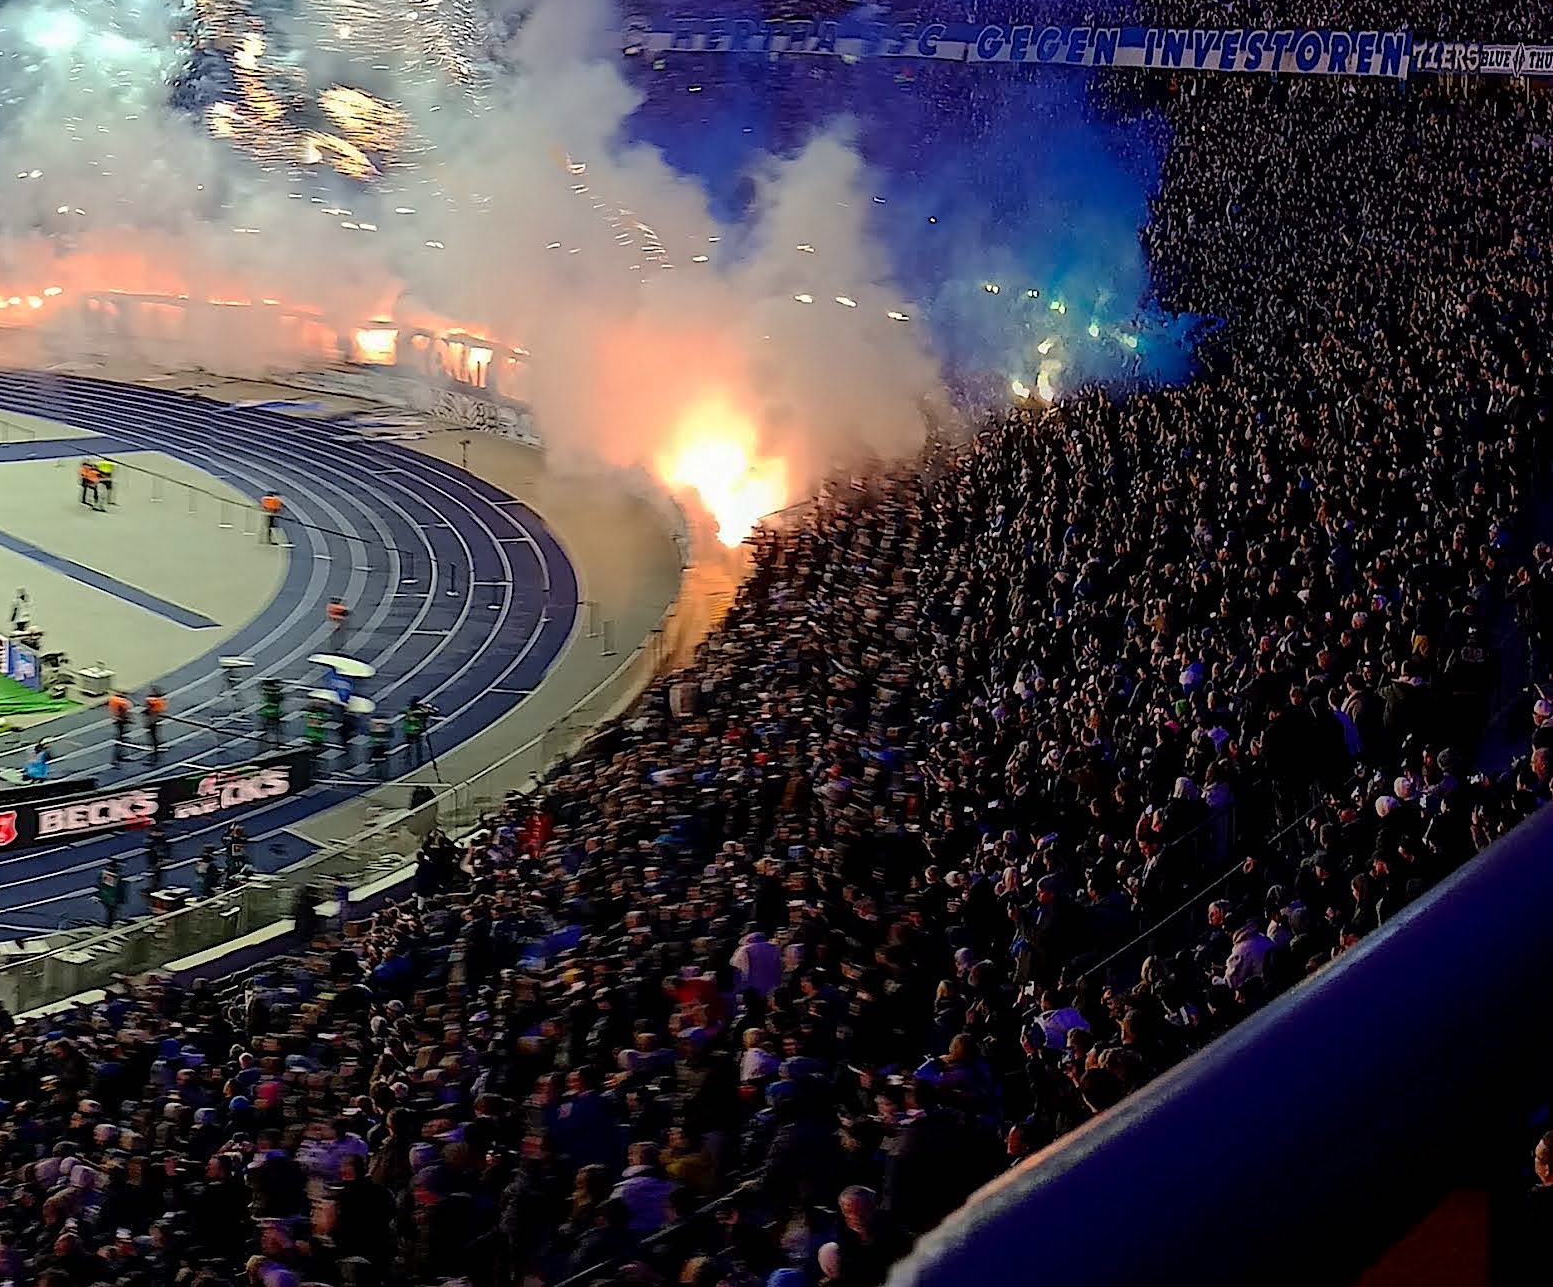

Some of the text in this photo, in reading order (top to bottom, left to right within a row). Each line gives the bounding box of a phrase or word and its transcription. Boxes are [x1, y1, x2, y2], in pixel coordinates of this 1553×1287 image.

[975, 25, 1406, 77] GEGEN INVESTOREN
[1481, 50, 1511, 68] BLUE
